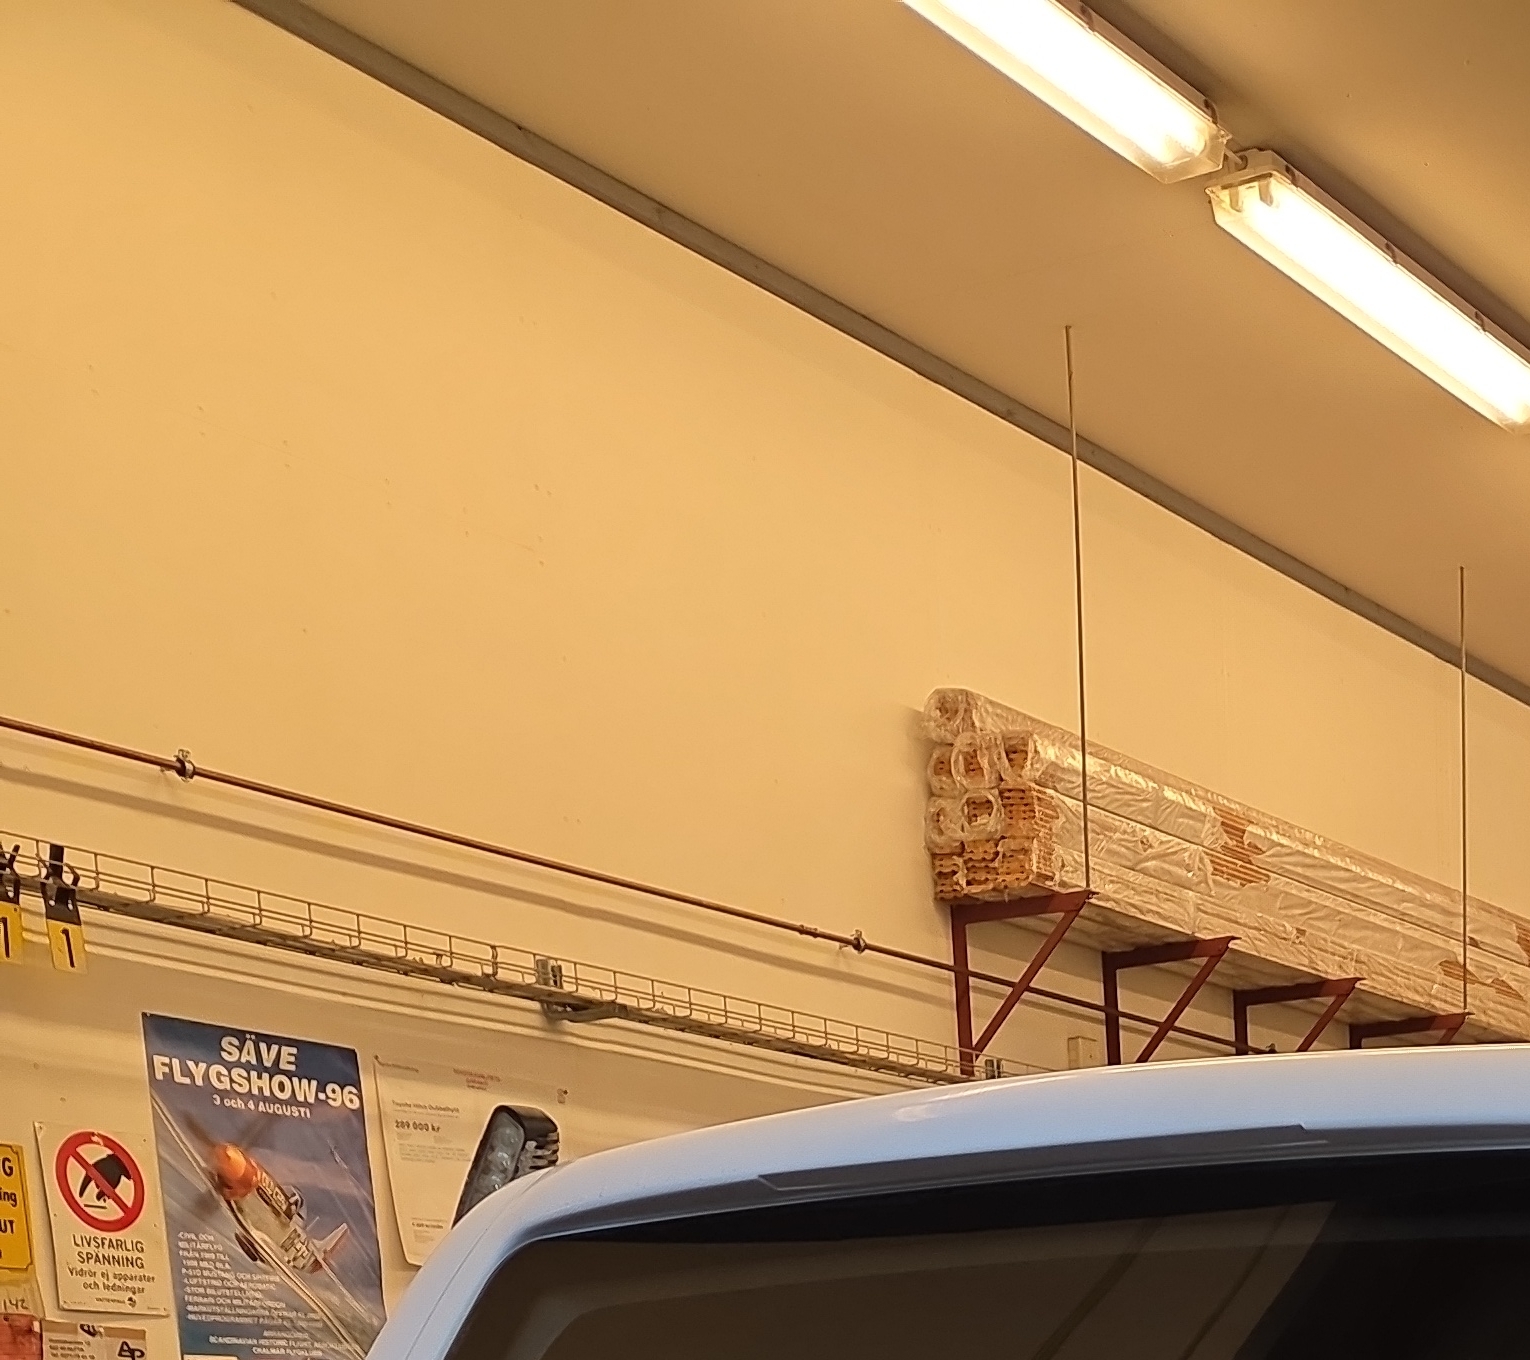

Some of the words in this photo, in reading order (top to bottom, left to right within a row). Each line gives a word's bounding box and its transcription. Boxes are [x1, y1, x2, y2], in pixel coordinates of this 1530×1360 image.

[220, 1033, 298, 1072] SÄVE
[152, 1054, 360, 1111] FLYGSHOW-96
[212, 1093, 221, 1106] 3
[223, 1095, 246, 1110] och
[247, 1100, 255, 1111] 4
[72, 1233, 145, 1254] LIVSFARLIG
[77, 1249, 145, 1270] SPÄNNING
[82, 1280, 100, 1291] och
